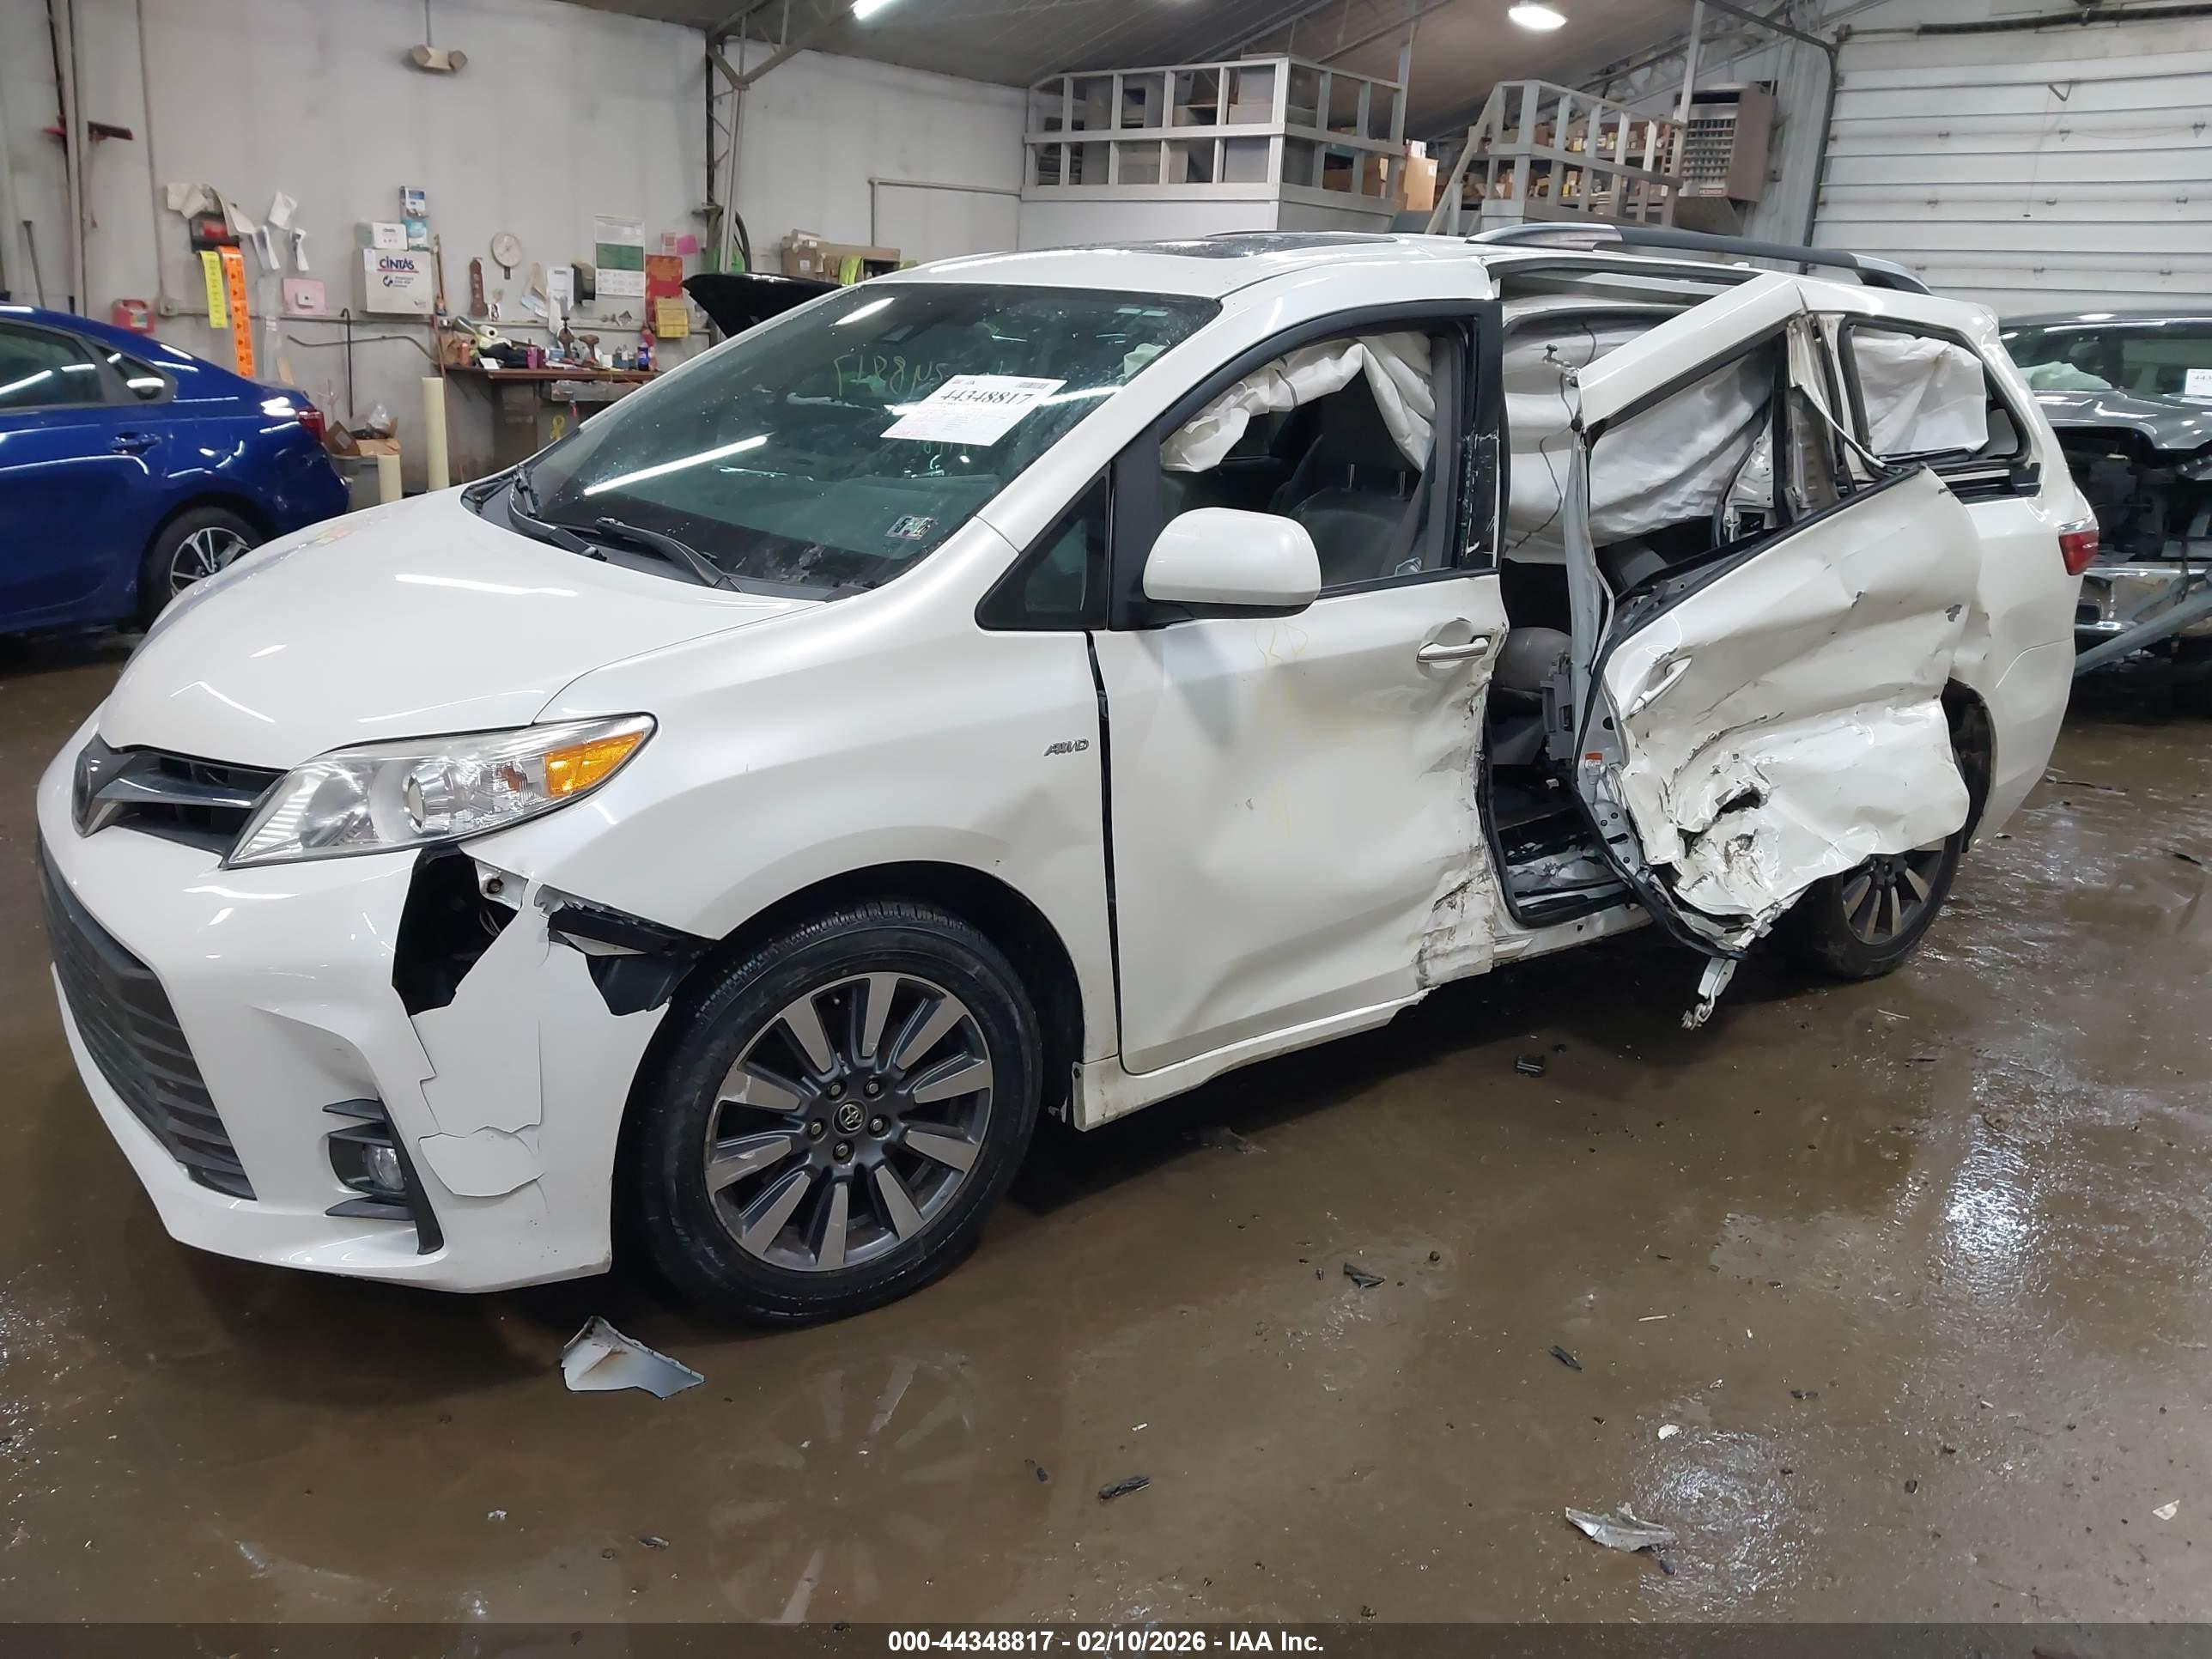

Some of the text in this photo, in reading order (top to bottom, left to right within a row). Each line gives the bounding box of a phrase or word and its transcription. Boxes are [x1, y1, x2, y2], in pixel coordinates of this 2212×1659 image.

[379, 255, 415, 270] CINTAS
[940, 389, 1035, 405] 44348817
[1043, 738, 1090, 757] AWD
